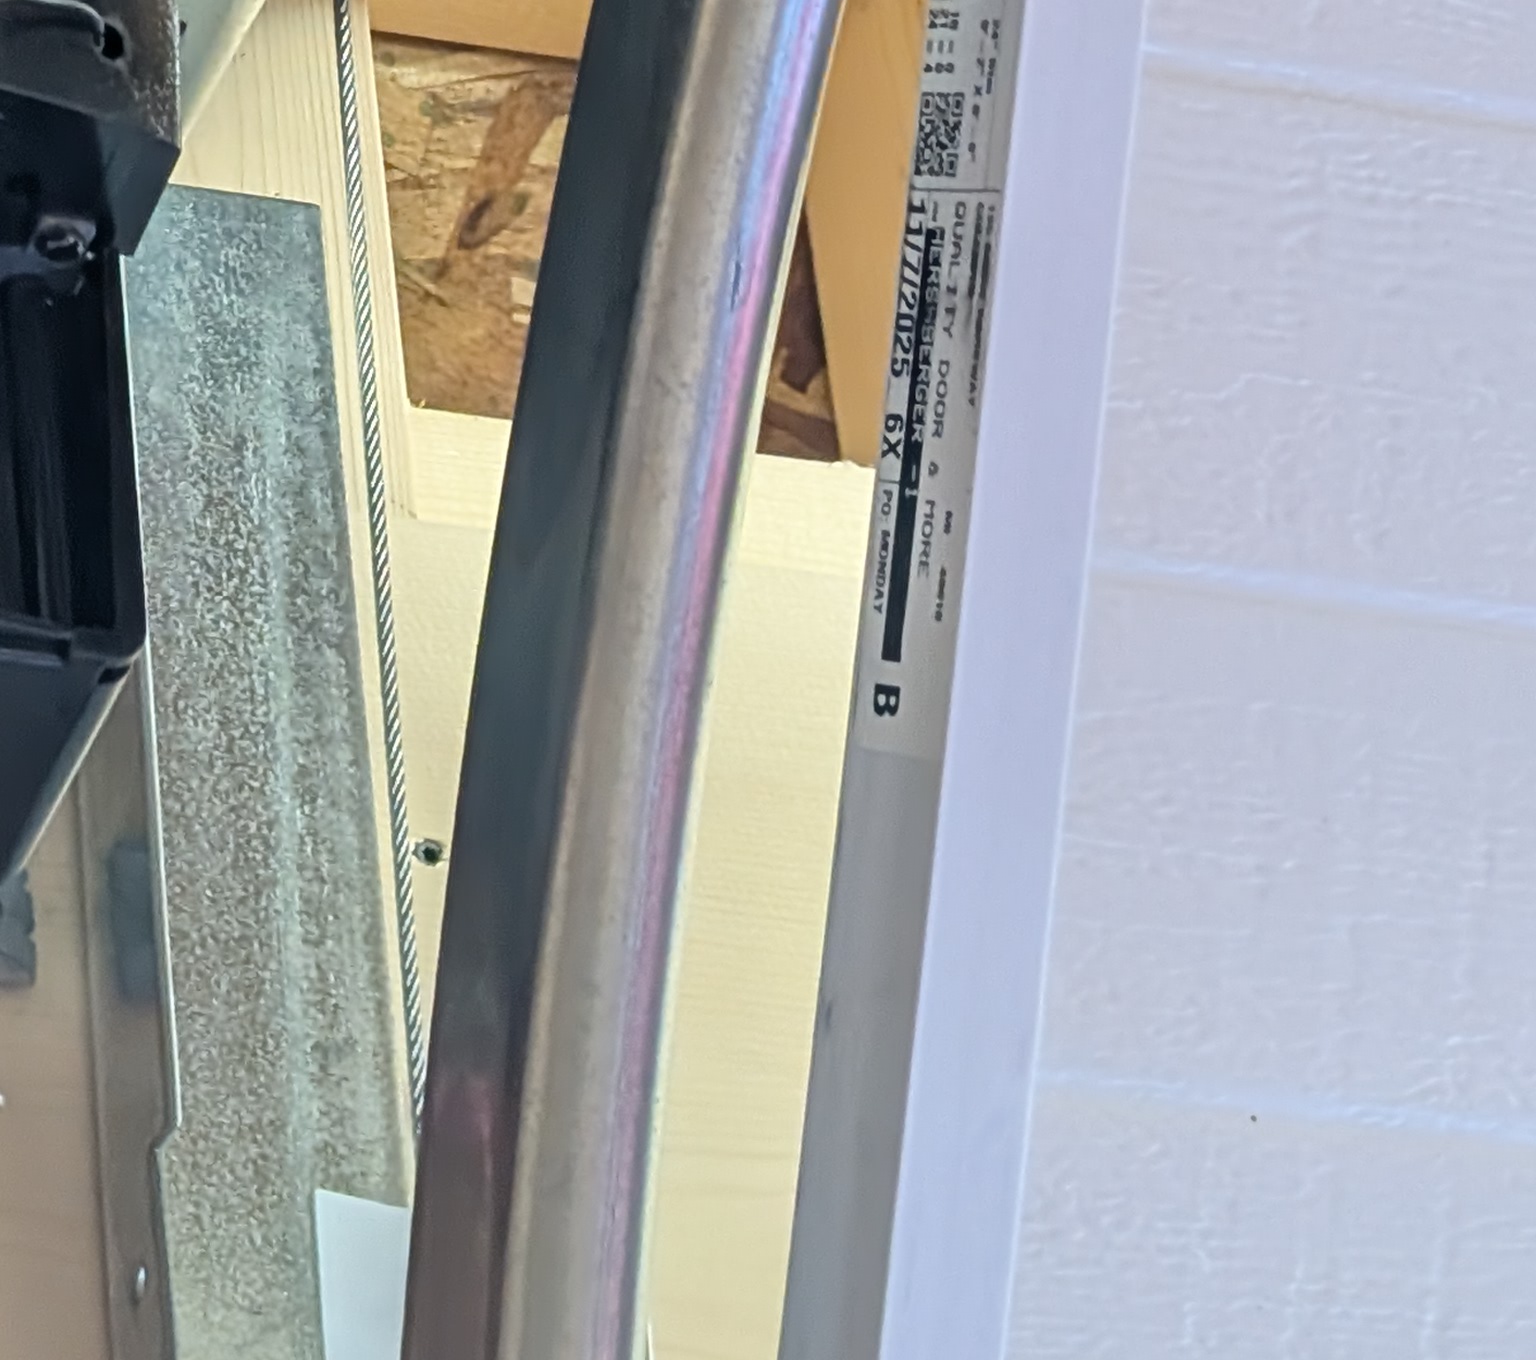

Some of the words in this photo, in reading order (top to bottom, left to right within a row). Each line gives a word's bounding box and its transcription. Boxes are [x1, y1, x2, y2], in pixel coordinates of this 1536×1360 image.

[891, 198, 928, 380] 11/7/2025
[941, 200, 967, 339] QUALITY
[881, 412, 904, 461] 6X
[931, 359, 950, 439] DOOR
[871, 529, 890, 614] MONDAY
[916, 498, 936, 579] MORE
[871, 682, 901, 720] B
